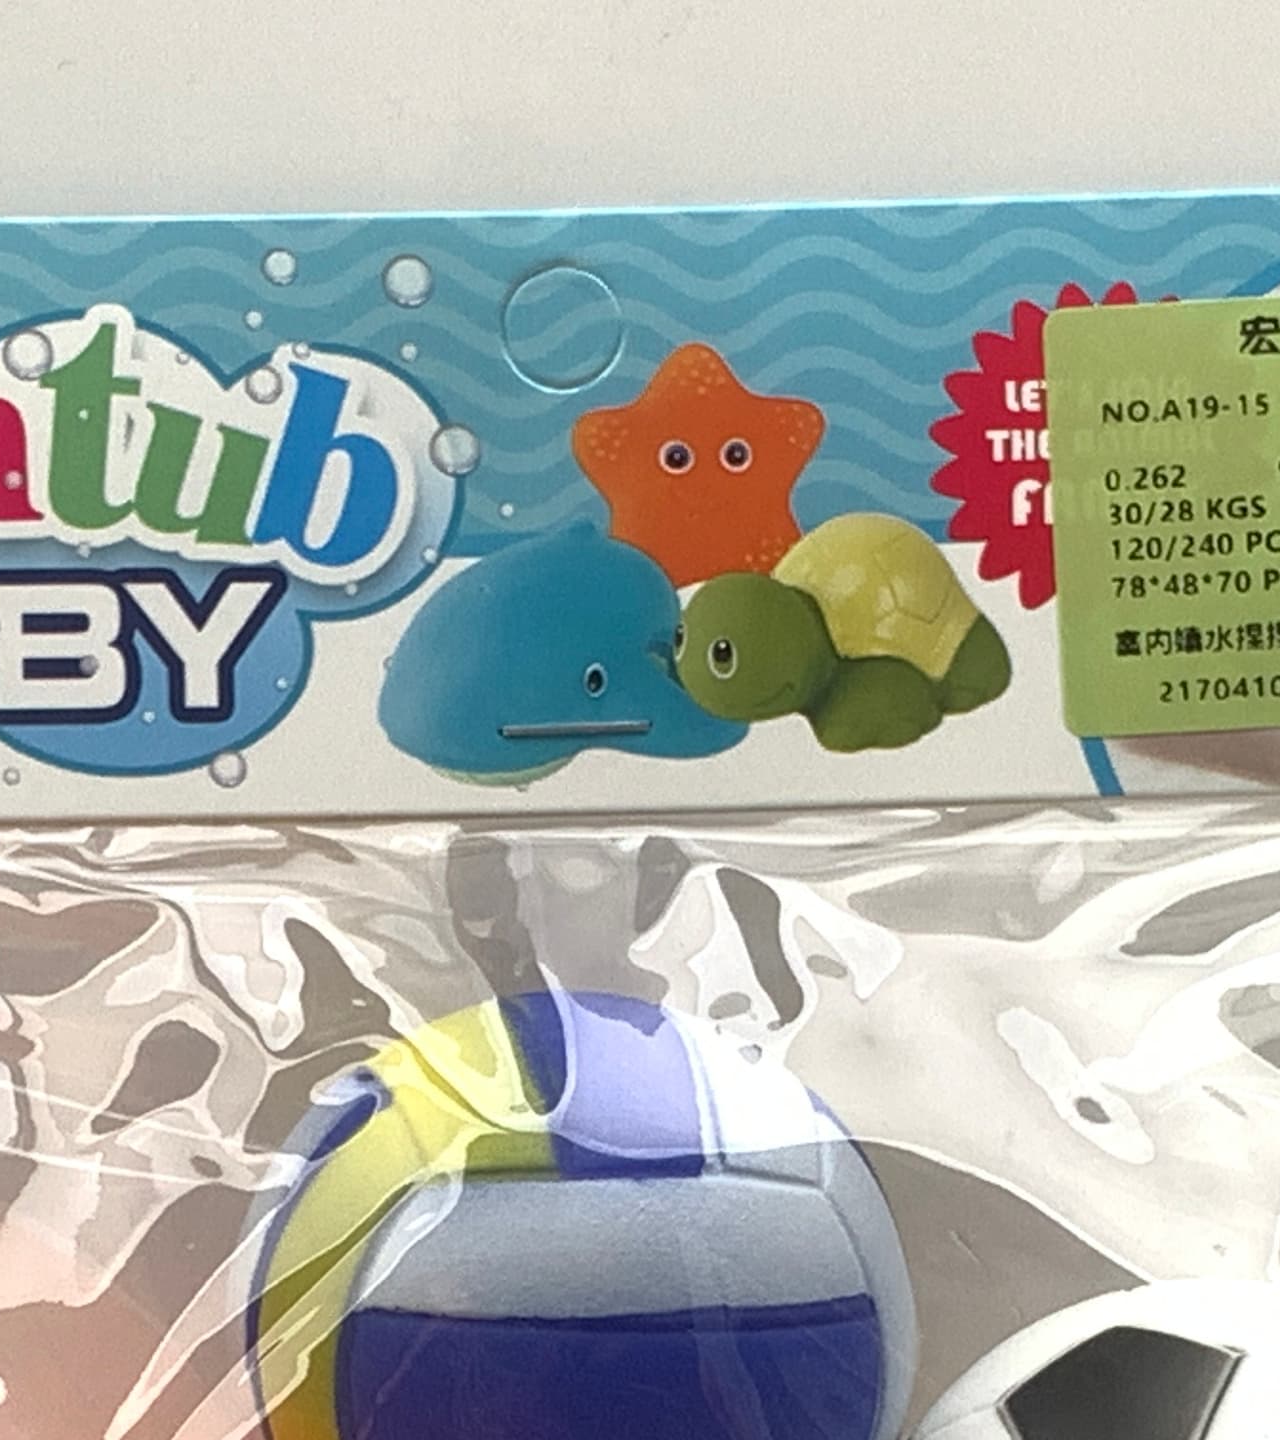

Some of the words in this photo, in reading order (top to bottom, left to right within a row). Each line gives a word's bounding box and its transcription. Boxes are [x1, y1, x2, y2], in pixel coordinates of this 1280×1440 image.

[1102, 394, 1268, 423] NO.A19-15
[1105, 465, 1186, 491] 0.262
[1110, 499, 1194, 526] 30/28
[1207, 495, 1266, 520] KGS
[1112, 533, 1233, 562] 120/240
